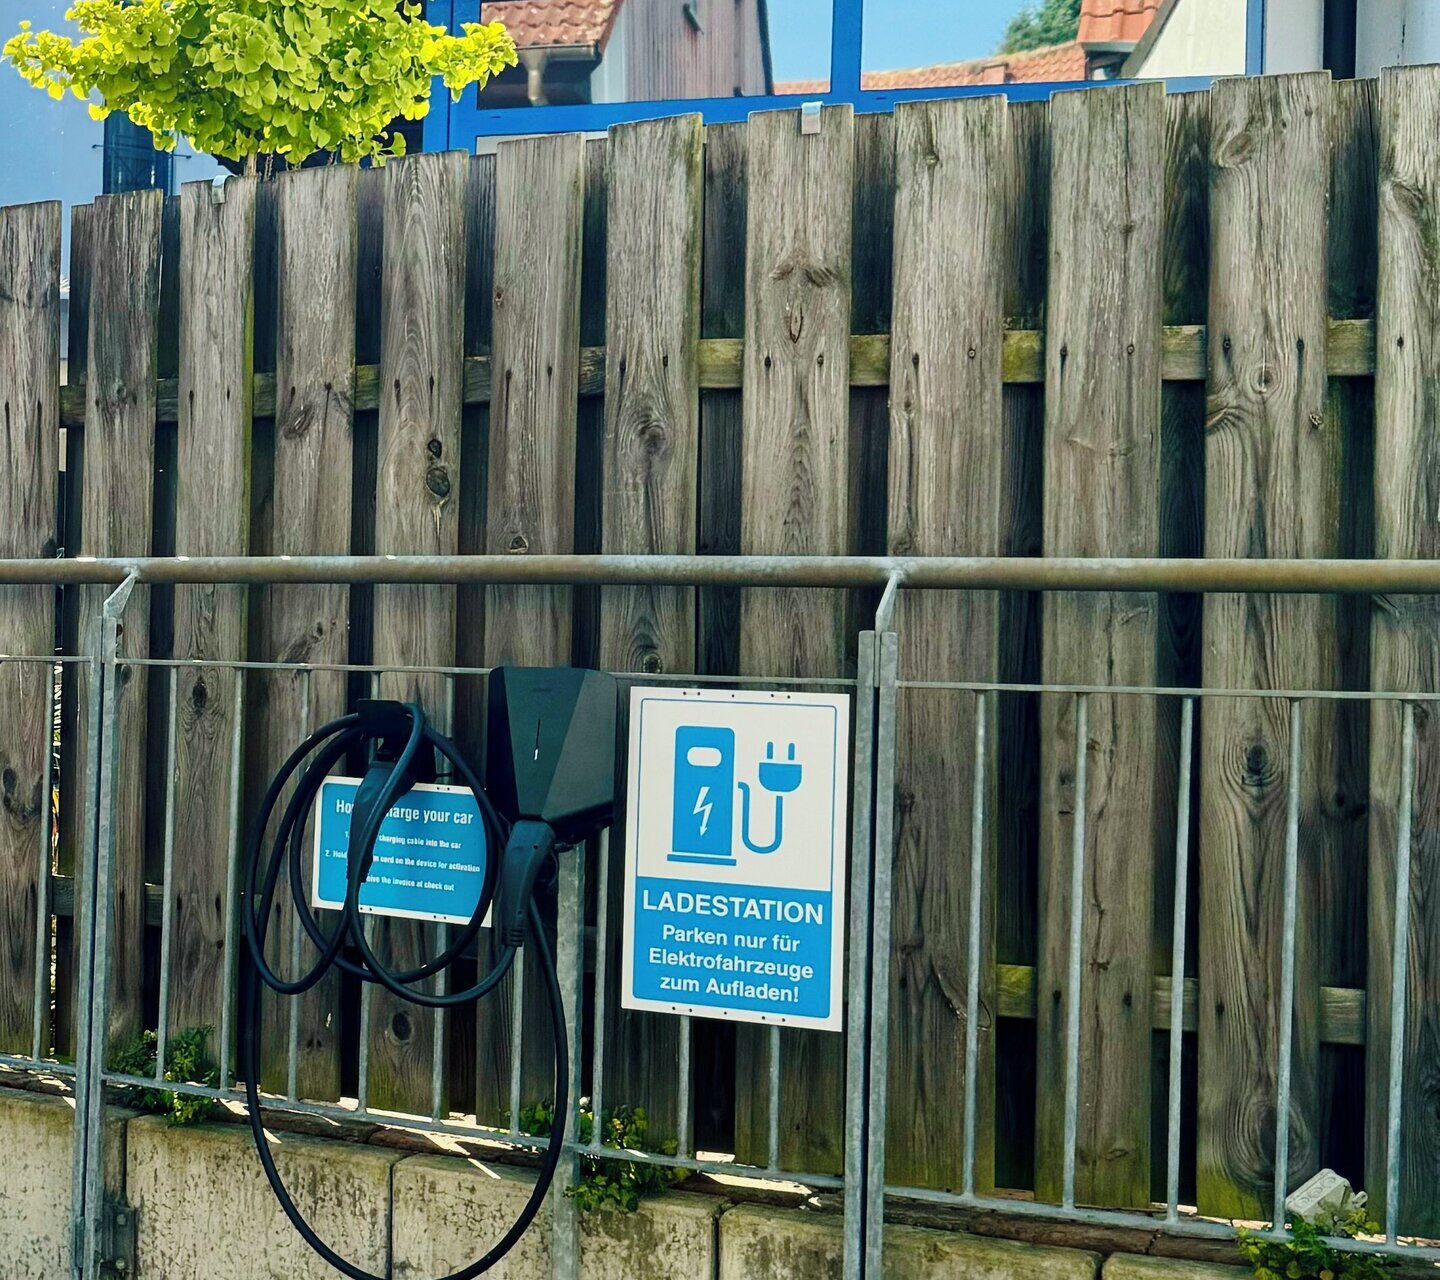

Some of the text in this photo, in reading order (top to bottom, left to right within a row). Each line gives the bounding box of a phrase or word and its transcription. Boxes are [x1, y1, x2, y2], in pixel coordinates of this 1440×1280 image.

[385, 807, 420, 823] harge
[423, 809, 450, 824] your
[453, 812, 474, 825] car
[379, 834, 406, 846] charging
[406, 837, 425, 846] cable
[425, 838, 438, 848] into
[439, 839, 450, 848] the
[395, 857, 404, 865] on
[404, 857, 415, 866] the
[415, 858, 437, 869] device
[437, 860, 448, 869] for
[448, 862, 481, 873] activation
[381, 875, 392, 885] the
[392, 877, 416, 888] invoice
[416, 880, 423, 888] at
[423, 880, 443, 891] check
[443, 884, 455, 892] out
[643, 889, 824, 925] LADESTATION
[662, 924, 801, 953] Parken nur für
[648, 947, 814, 982] Elektrofahrzeuge
[659, 976, 800, 1003] zum Aufladen!
